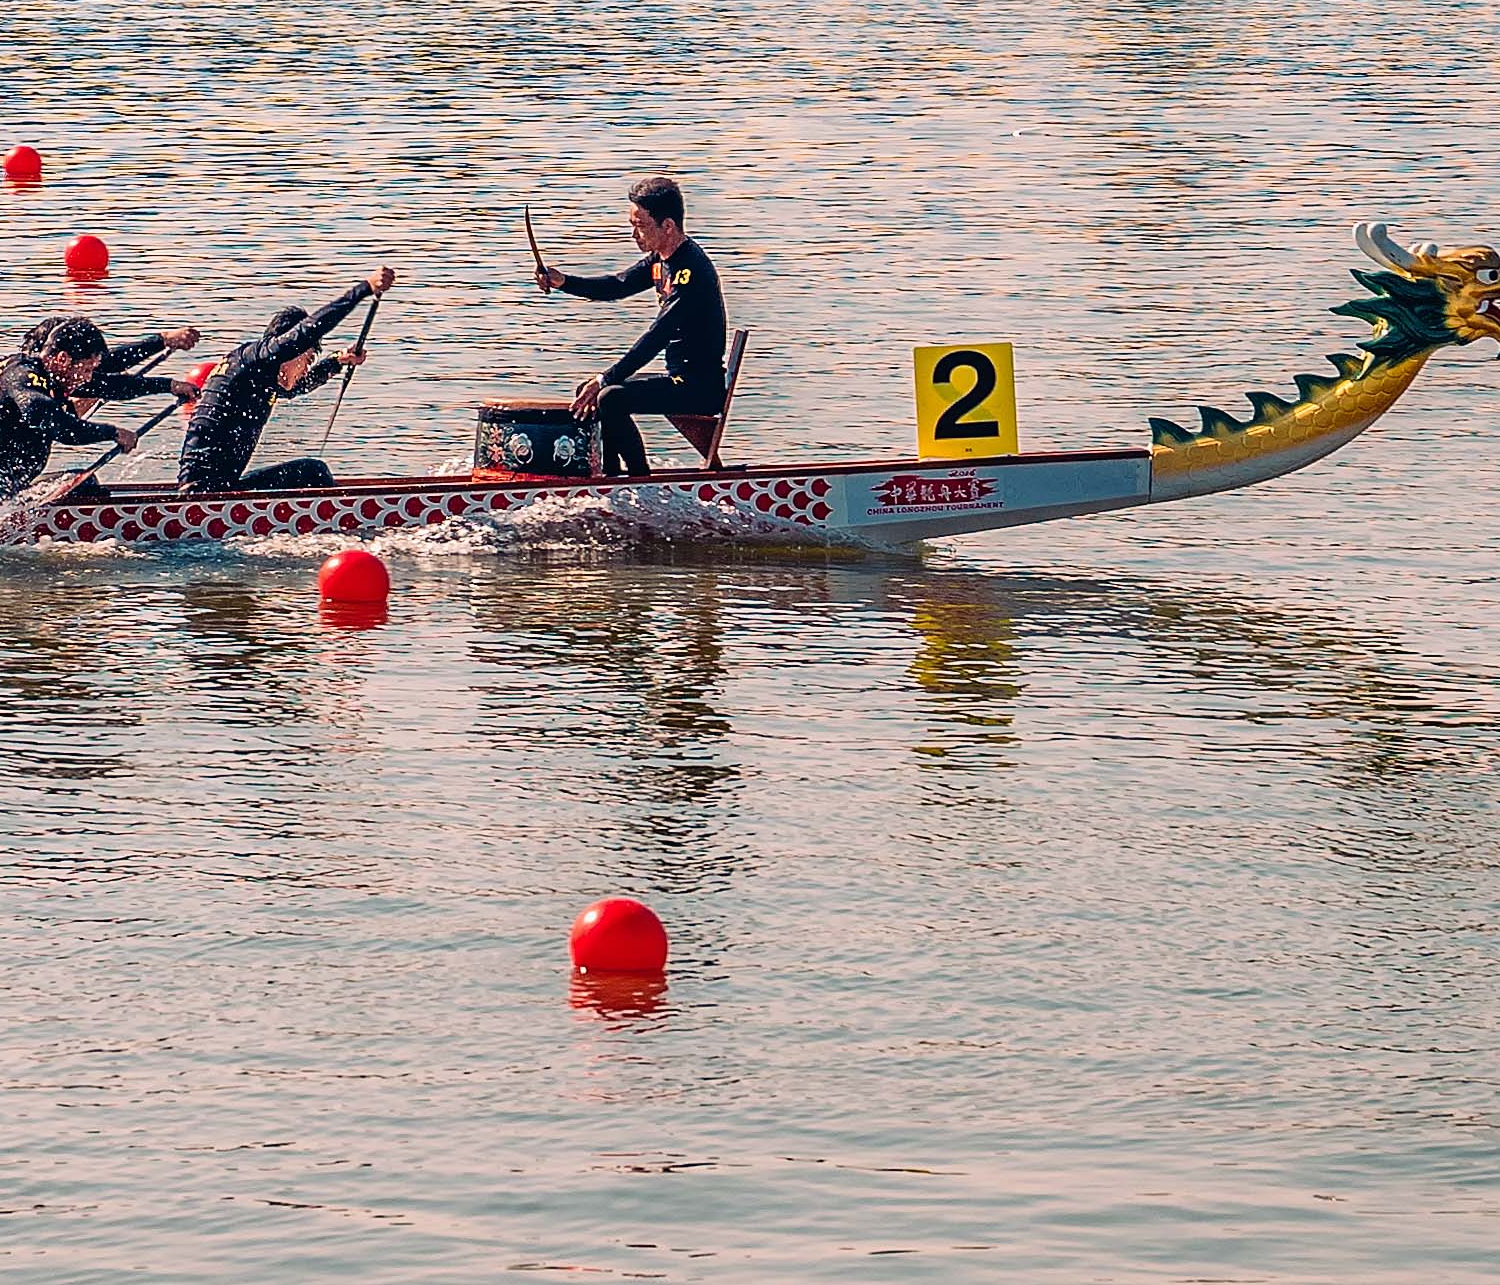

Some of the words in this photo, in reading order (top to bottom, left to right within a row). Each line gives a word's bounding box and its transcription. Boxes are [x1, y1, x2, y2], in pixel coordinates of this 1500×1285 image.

[932, 350, 1000, 441] 2
[948, 468, 976, 478] 2016
[866, 508, 895, 516] CHINA
[896, 505, 944, 514] LONGZHOU
[945, 501, 1004, 511] TOURNAMENT
